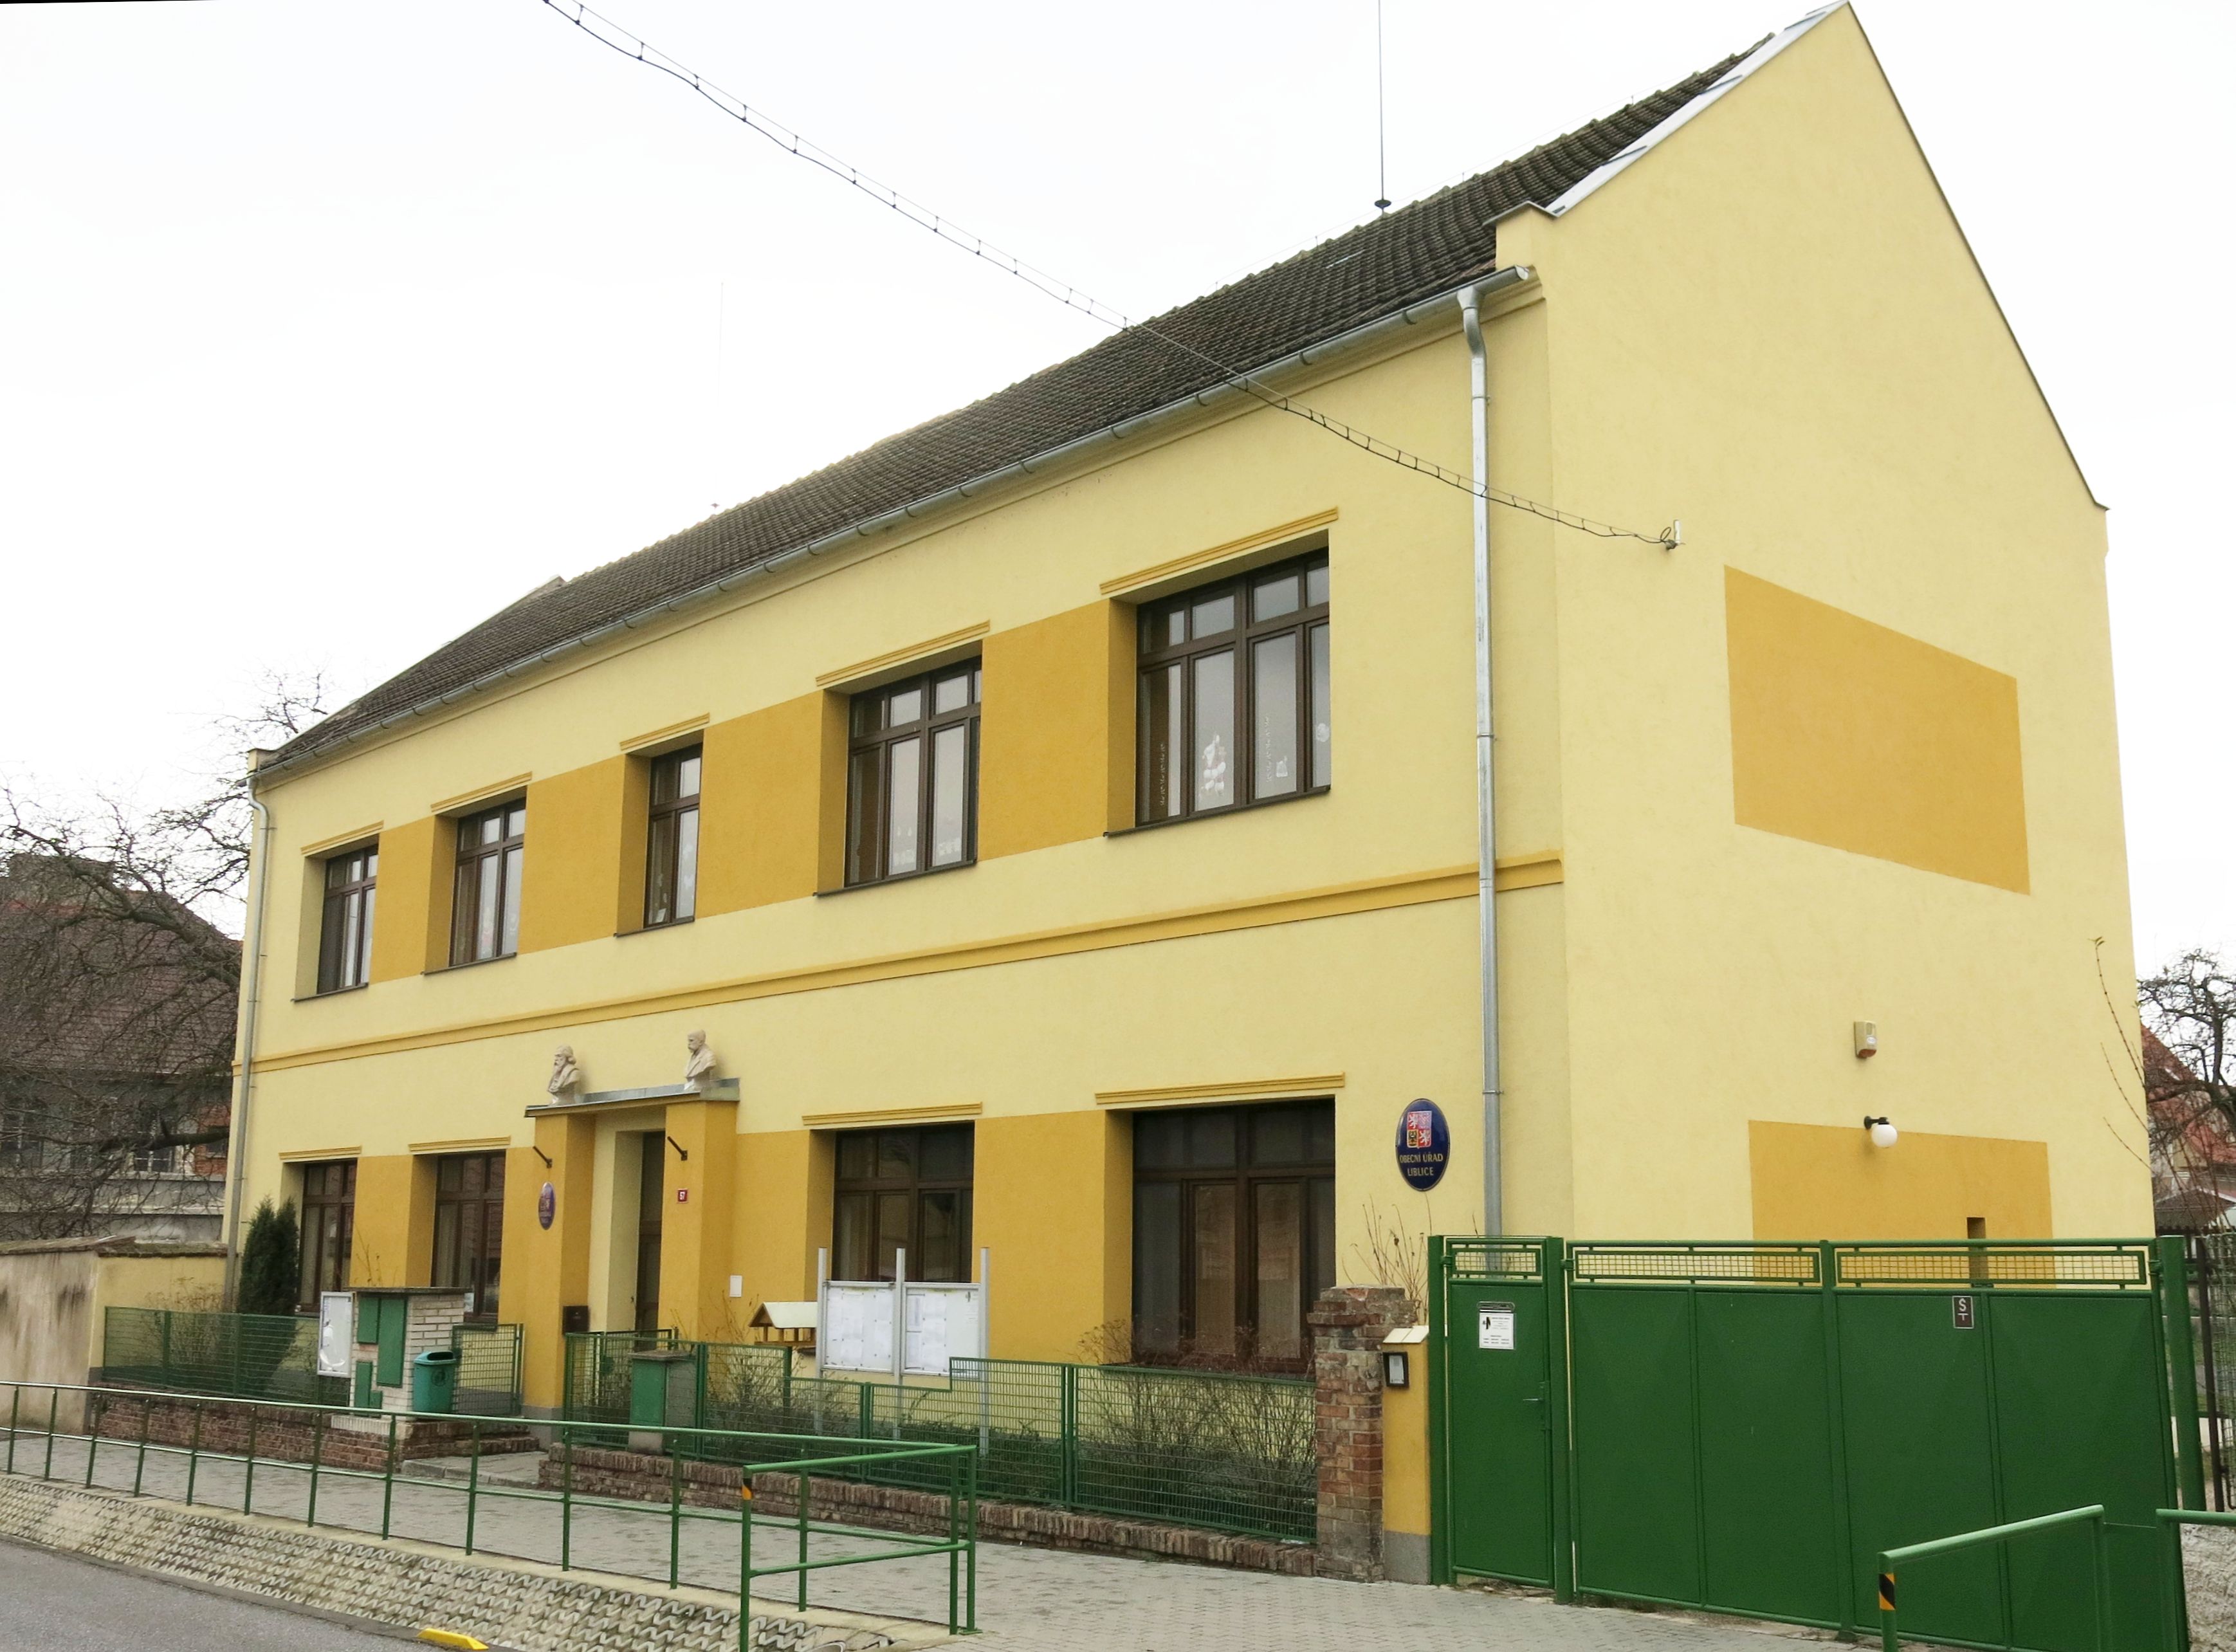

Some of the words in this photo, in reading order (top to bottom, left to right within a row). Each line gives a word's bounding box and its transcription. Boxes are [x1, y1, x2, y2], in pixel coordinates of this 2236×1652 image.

[1399, 1152, 1421, 1163] OBECNÍ
[1422, 1151, 1443, 1162] ÚŘAD
[1407, 1166, 1434, 1176] LIBLICE
